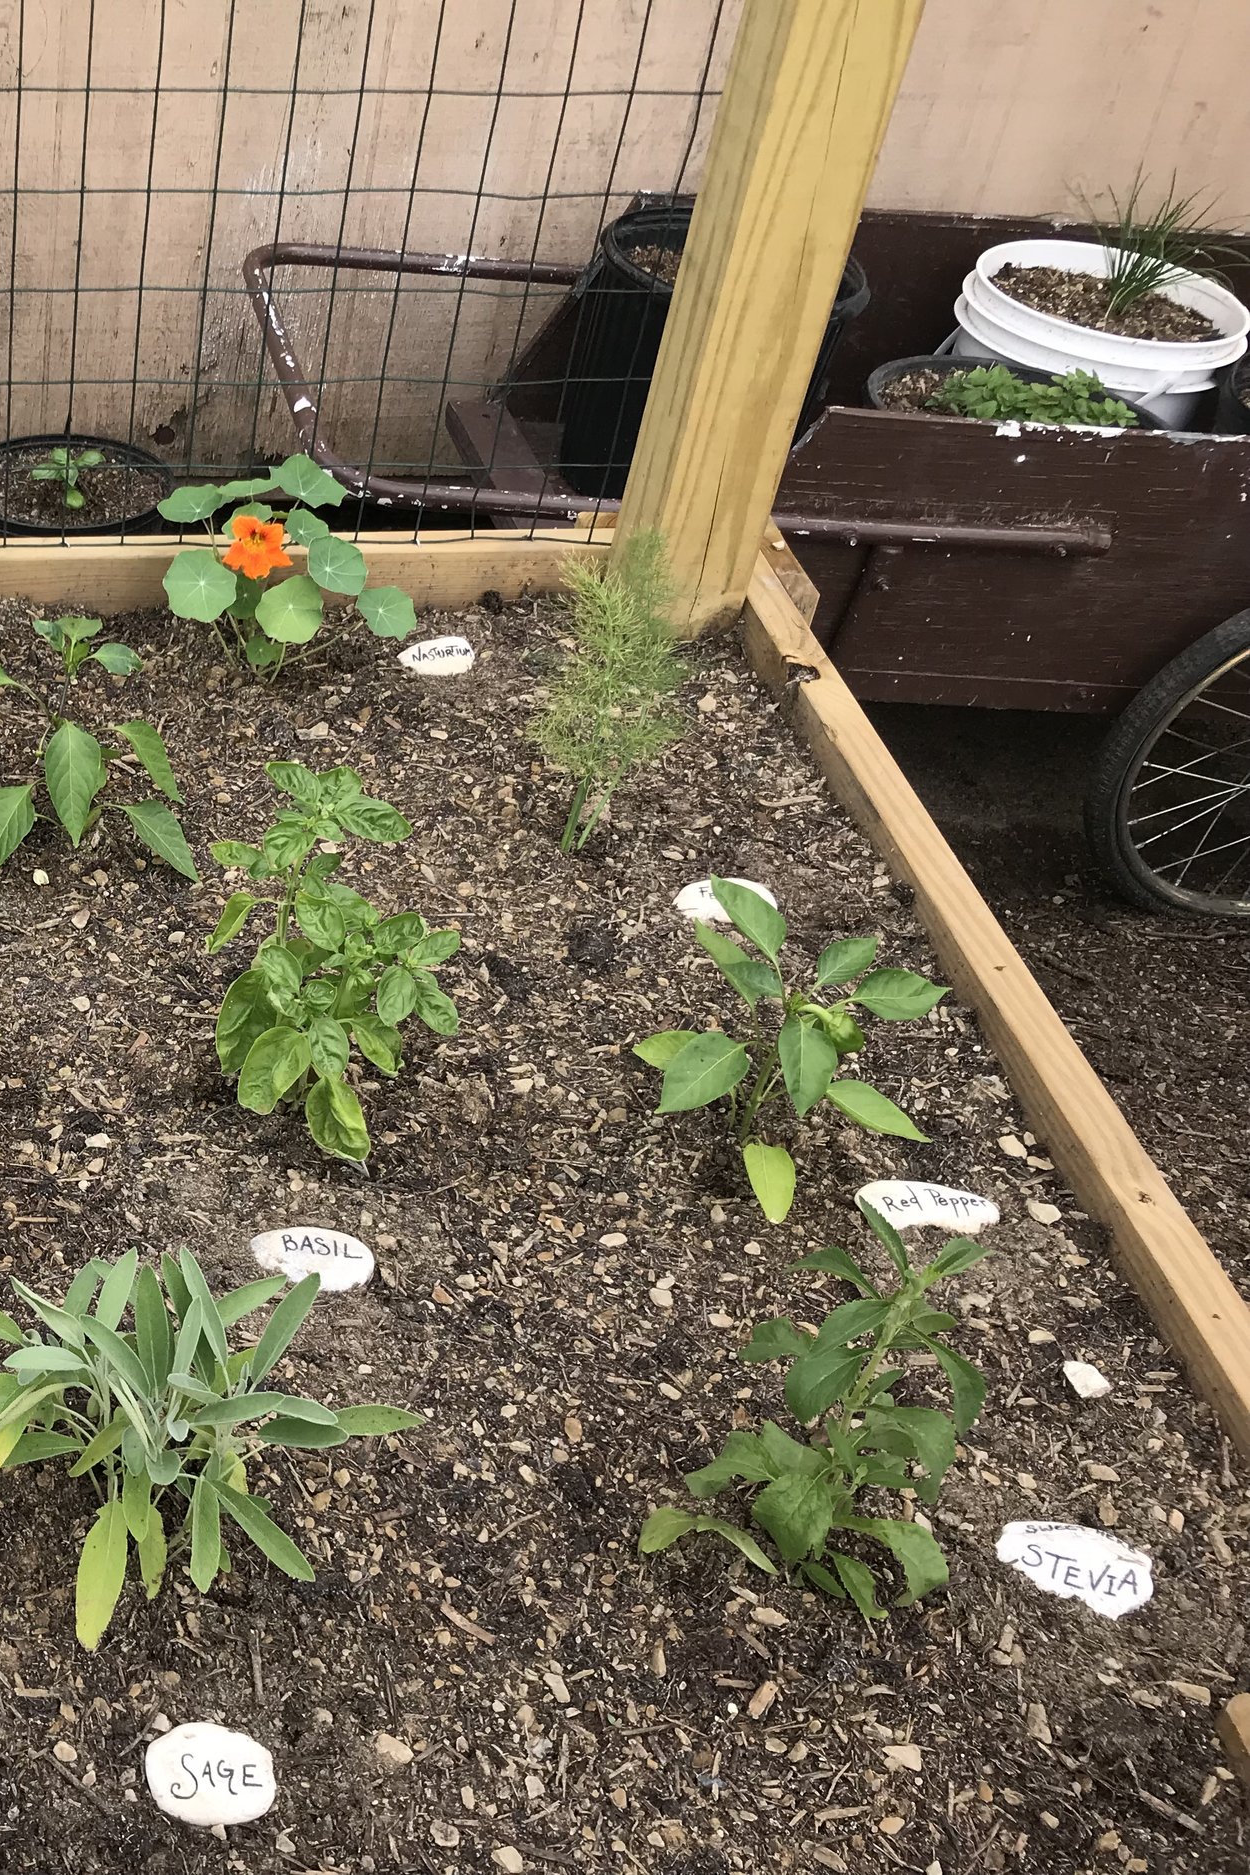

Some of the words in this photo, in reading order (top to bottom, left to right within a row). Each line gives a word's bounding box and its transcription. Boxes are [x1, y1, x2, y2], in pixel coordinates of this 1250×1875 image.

[412, 645, 472, 662] NASTURTIUM
[881, 1184, 923, 1212] Red
[923, 1188, 987, 1218] Pepper
[281, 1234, 363, 1259] BASIL
[1021, 1544, 1138, 1596] STEVIA
[170, 1753, 263, 1799] SAGE
